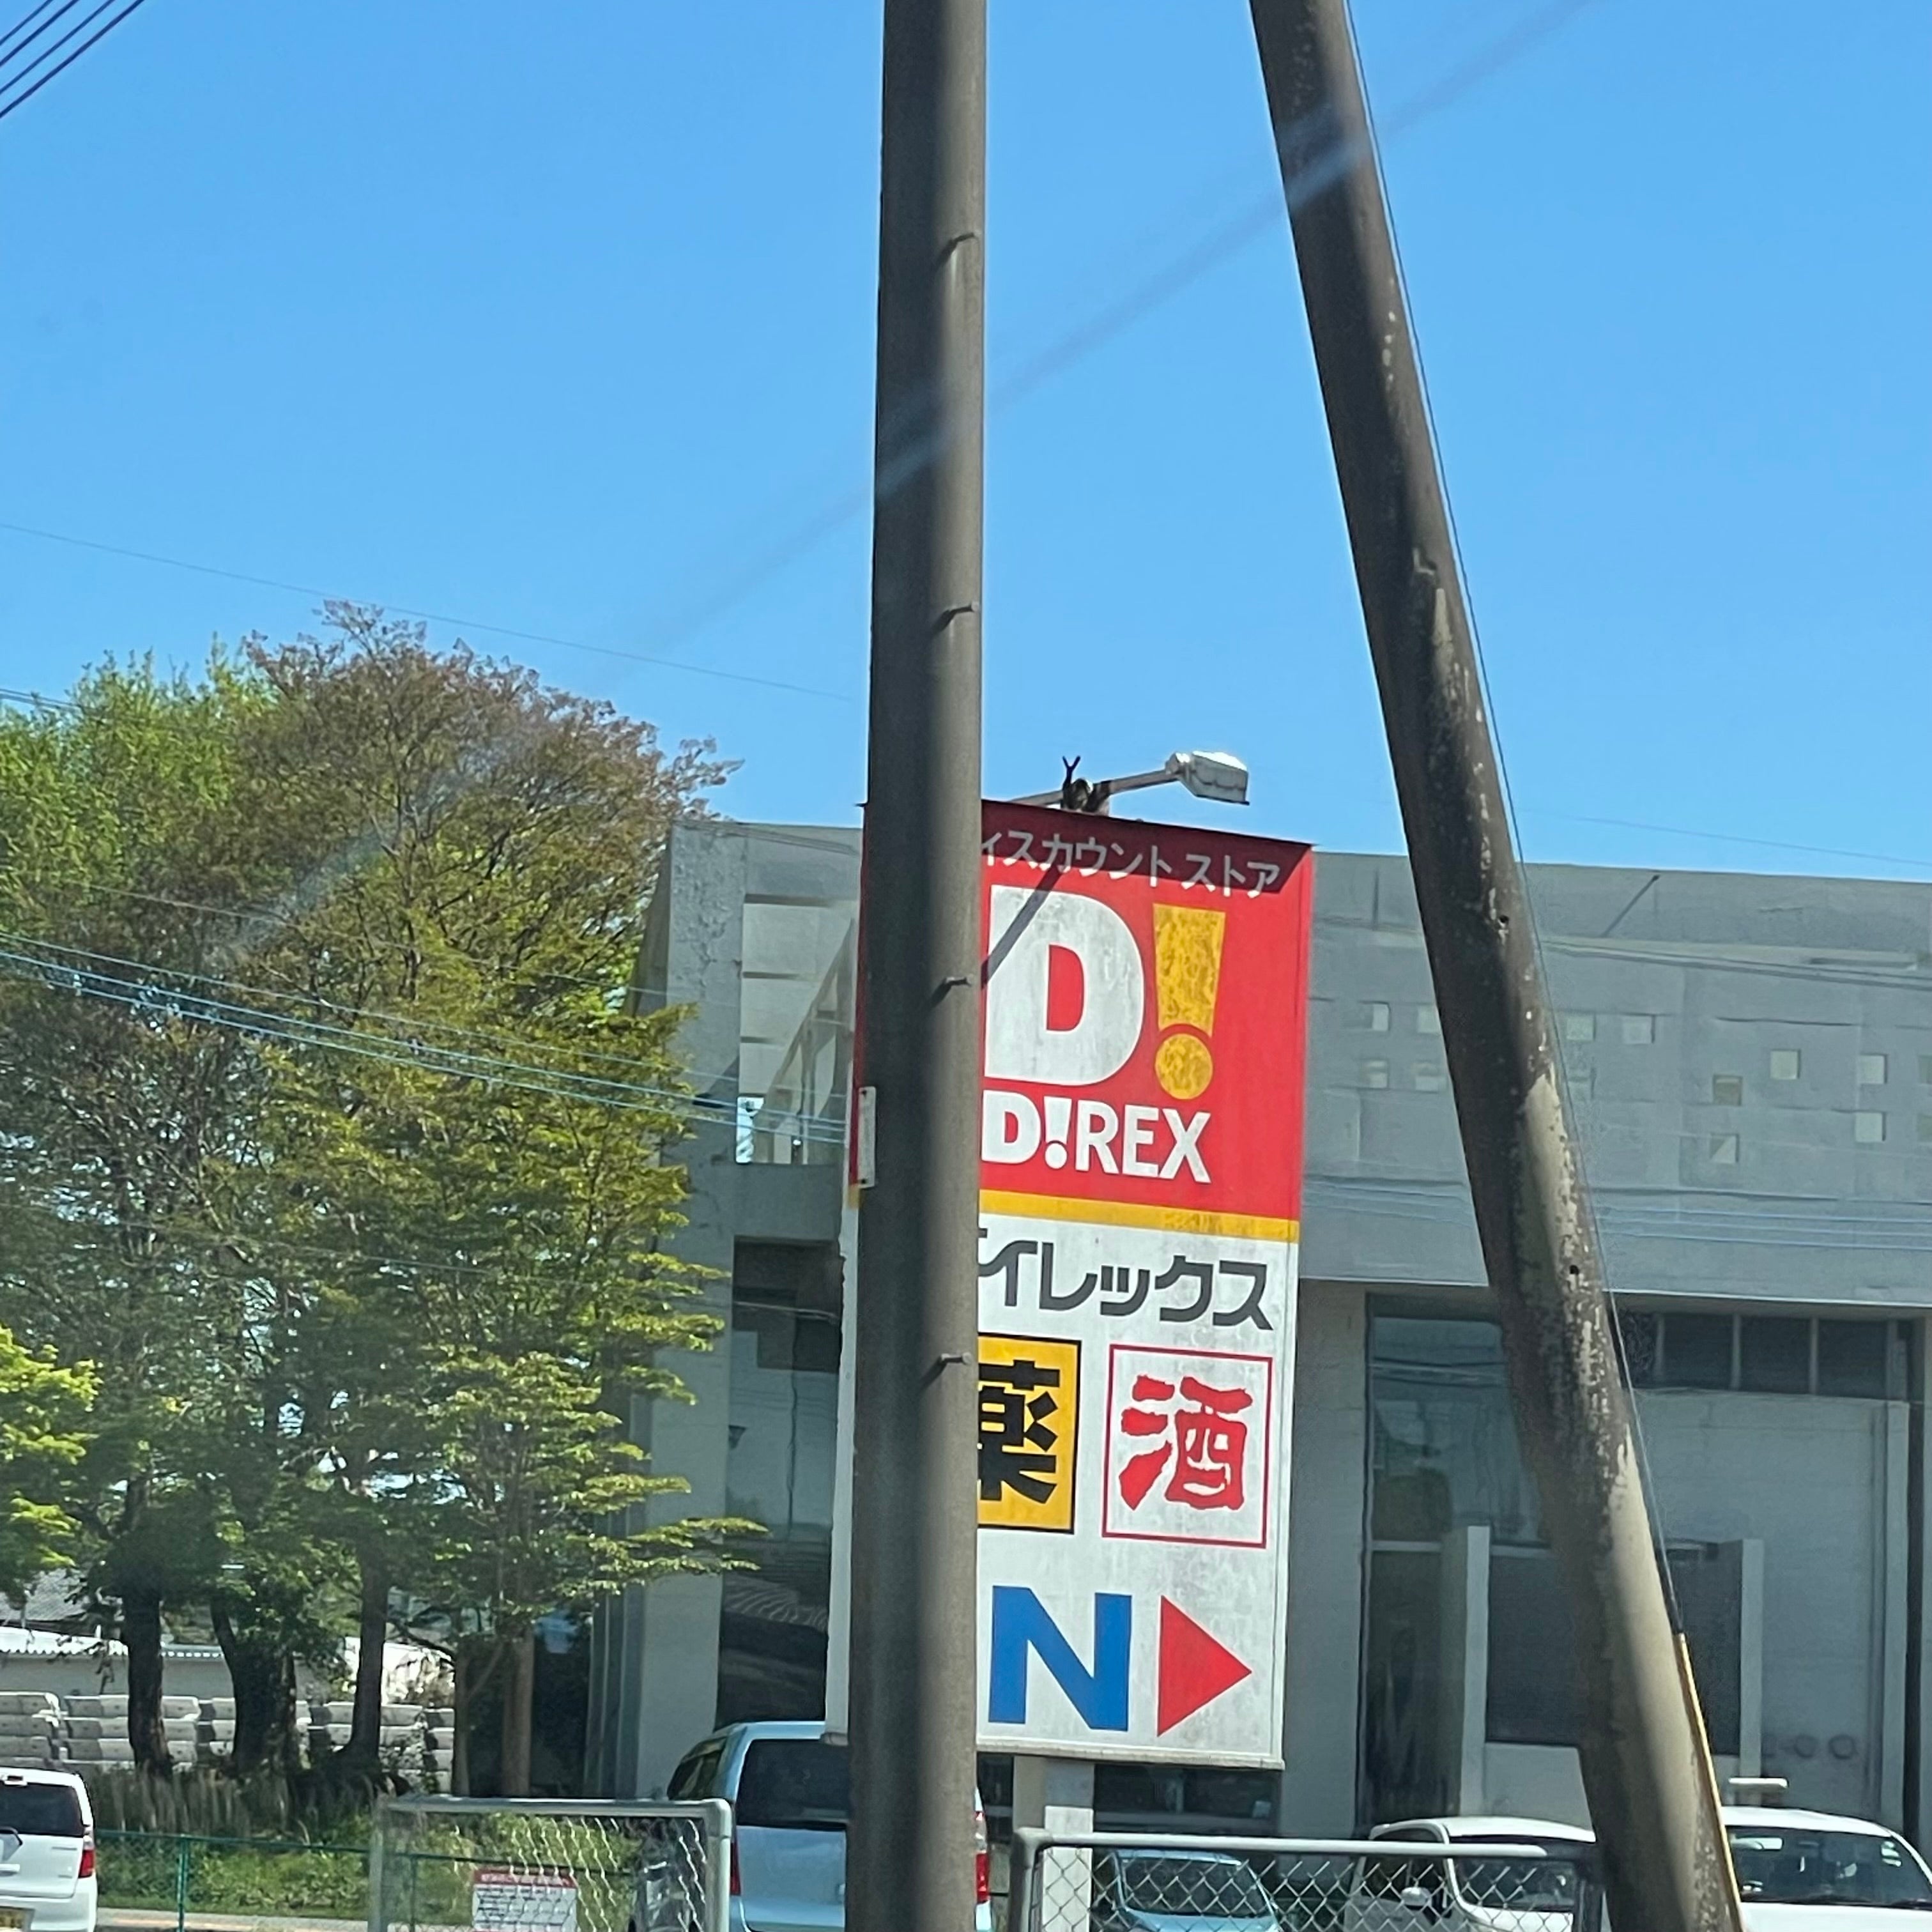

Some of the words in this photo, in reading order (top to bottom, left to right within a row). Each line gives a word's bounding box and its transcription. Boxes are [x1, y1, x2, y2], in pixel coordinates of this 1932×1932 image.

[978, 1227, 1273, 1330] イレックス
[1119, 1374, 1253, 1510] 酒
